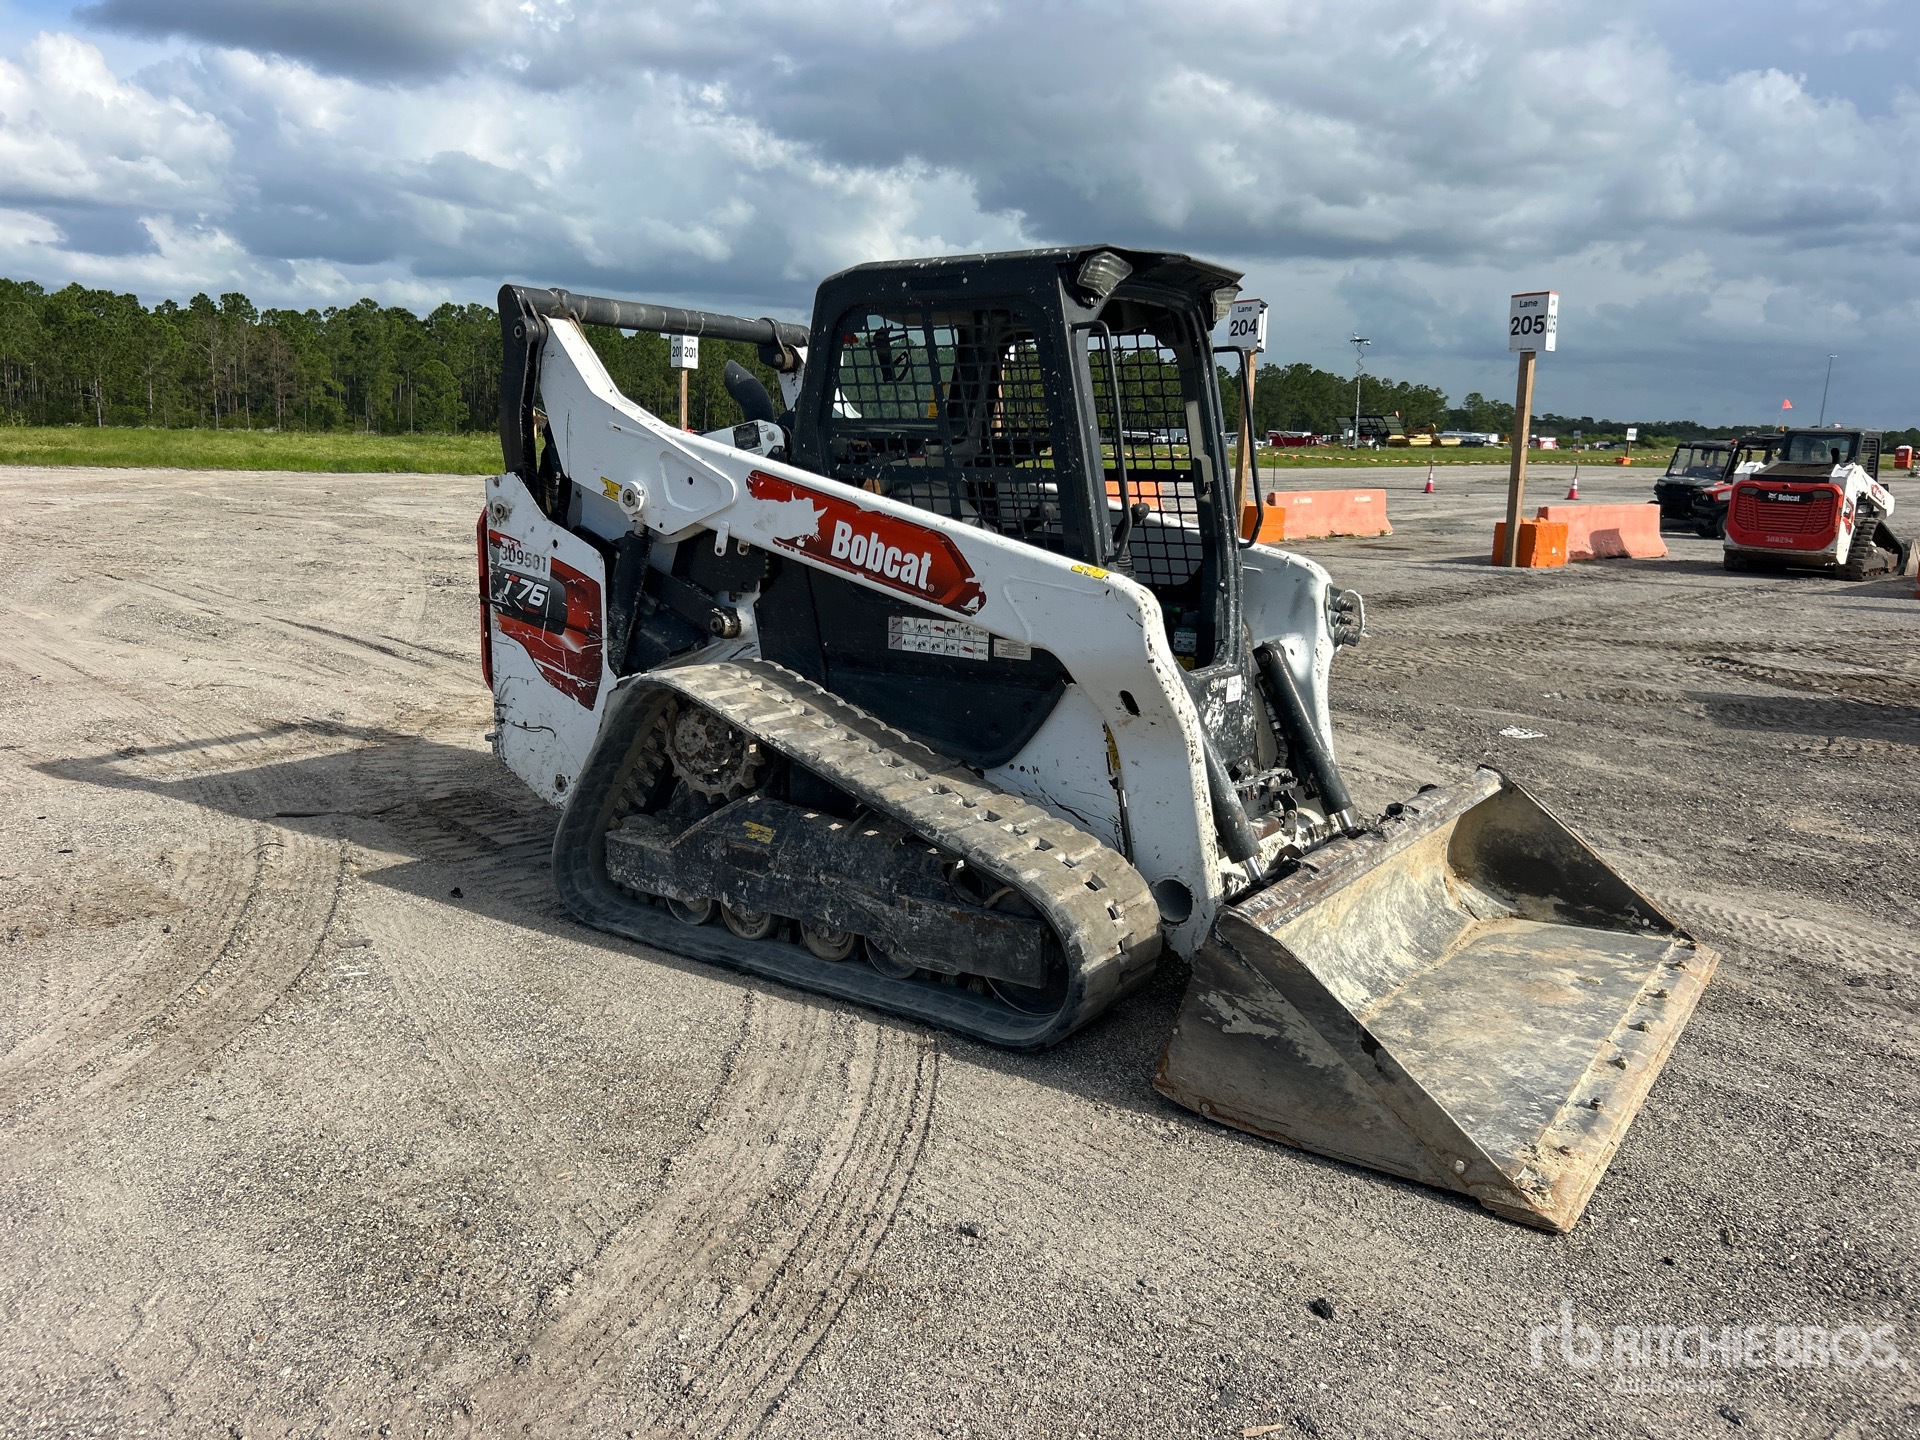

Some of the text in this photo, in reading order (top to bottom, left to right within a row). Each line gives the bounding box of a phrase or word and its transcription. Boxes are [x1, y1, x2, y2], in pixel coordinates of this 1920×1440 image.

[1519, 300, 1538, 308] Lane
[1230, 318, 1257, 337] 204
[1510, 314, 1545, 336] 205
[672, 345, 682, 358] 201
[684, 346, 697, 359] 201
[1777, 493, 1800, 502] Bobcat
[830, 519, 932, 591] Bobcat
[503, 572, 550, 608] T76
